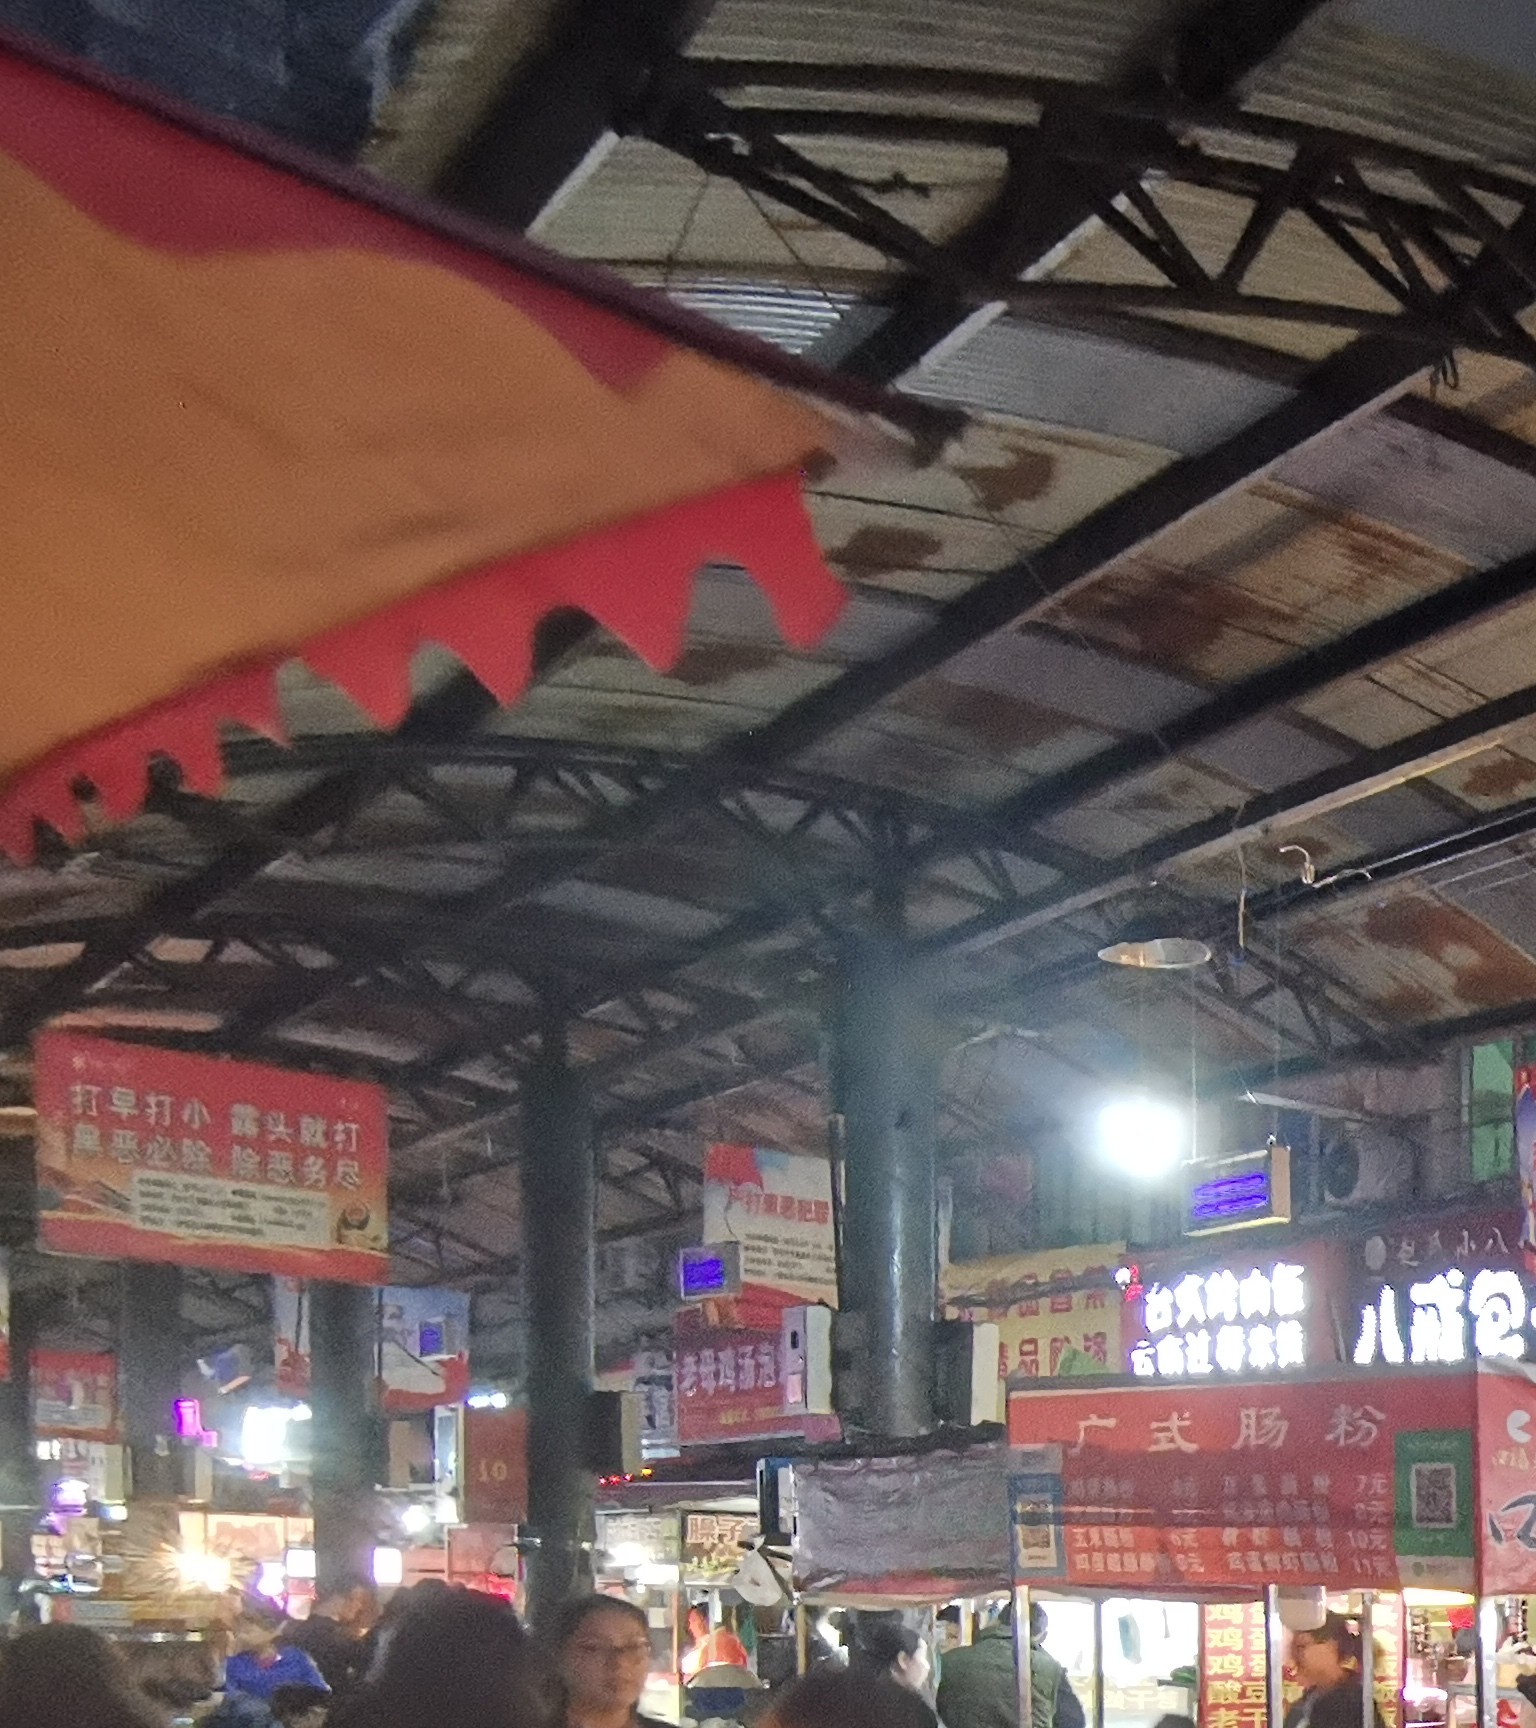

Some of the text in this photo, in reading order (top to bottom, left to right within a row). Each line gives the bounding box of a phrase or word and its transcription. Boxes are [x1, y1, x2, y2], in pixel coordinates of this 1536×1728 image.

[69, 1083, 211, 1129] 打早打小
[1067, 1403, 1385, 1456] 广式肠粉
